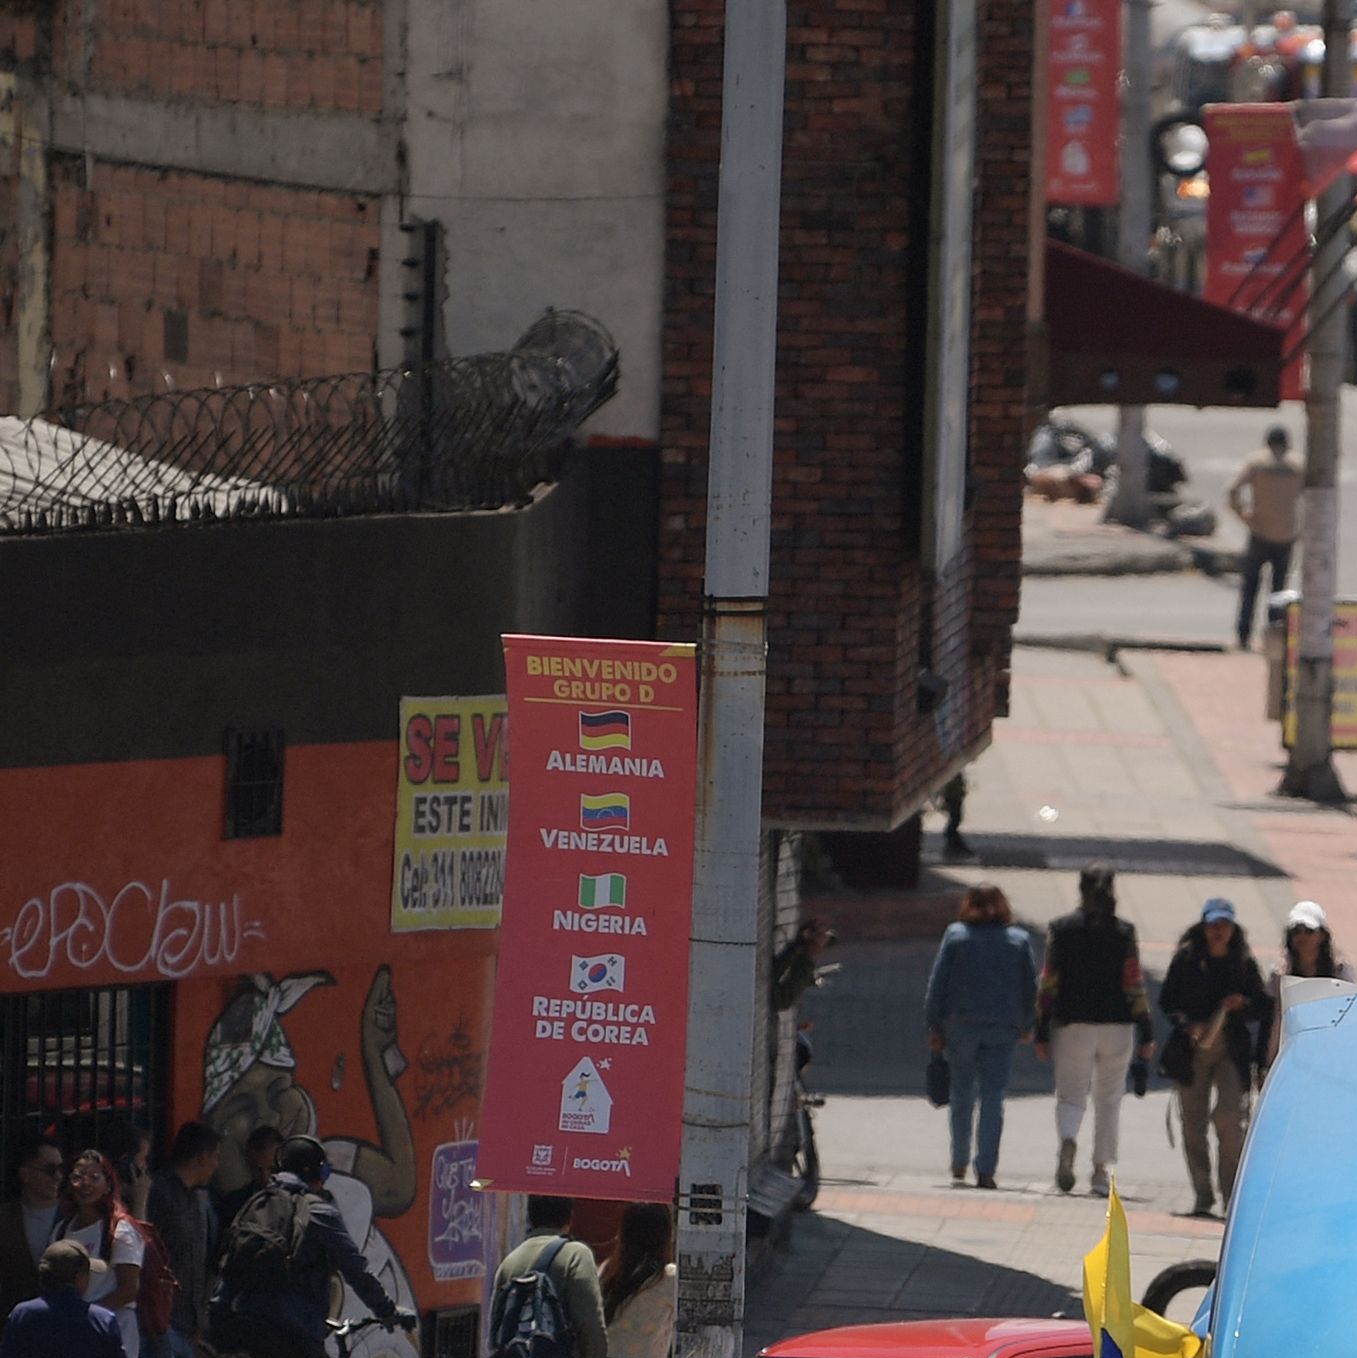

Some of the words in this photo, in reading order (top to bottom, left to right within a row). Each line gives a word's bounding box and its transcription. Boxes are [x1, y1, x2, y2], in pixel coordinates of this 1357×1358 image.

[526, 655, 677, 684] BIENVENIDO
[553, 679, 631, 702] GRUPO
[639, 684, 655, 702] D
[403, 713, 461, 784] SE
[546, 750, 664, 778] ALEMANIA
[412, 795, 472, 834] ESTE
[540, 828, 669, 856] VENEZUELA
[553, 910, 647, 936] NIGERIA
[532, 995, 656, 1024] REPÚBLICA
[535, 1020, 565, 1040] DE
[571, 1020, 649, 1046] COREA
